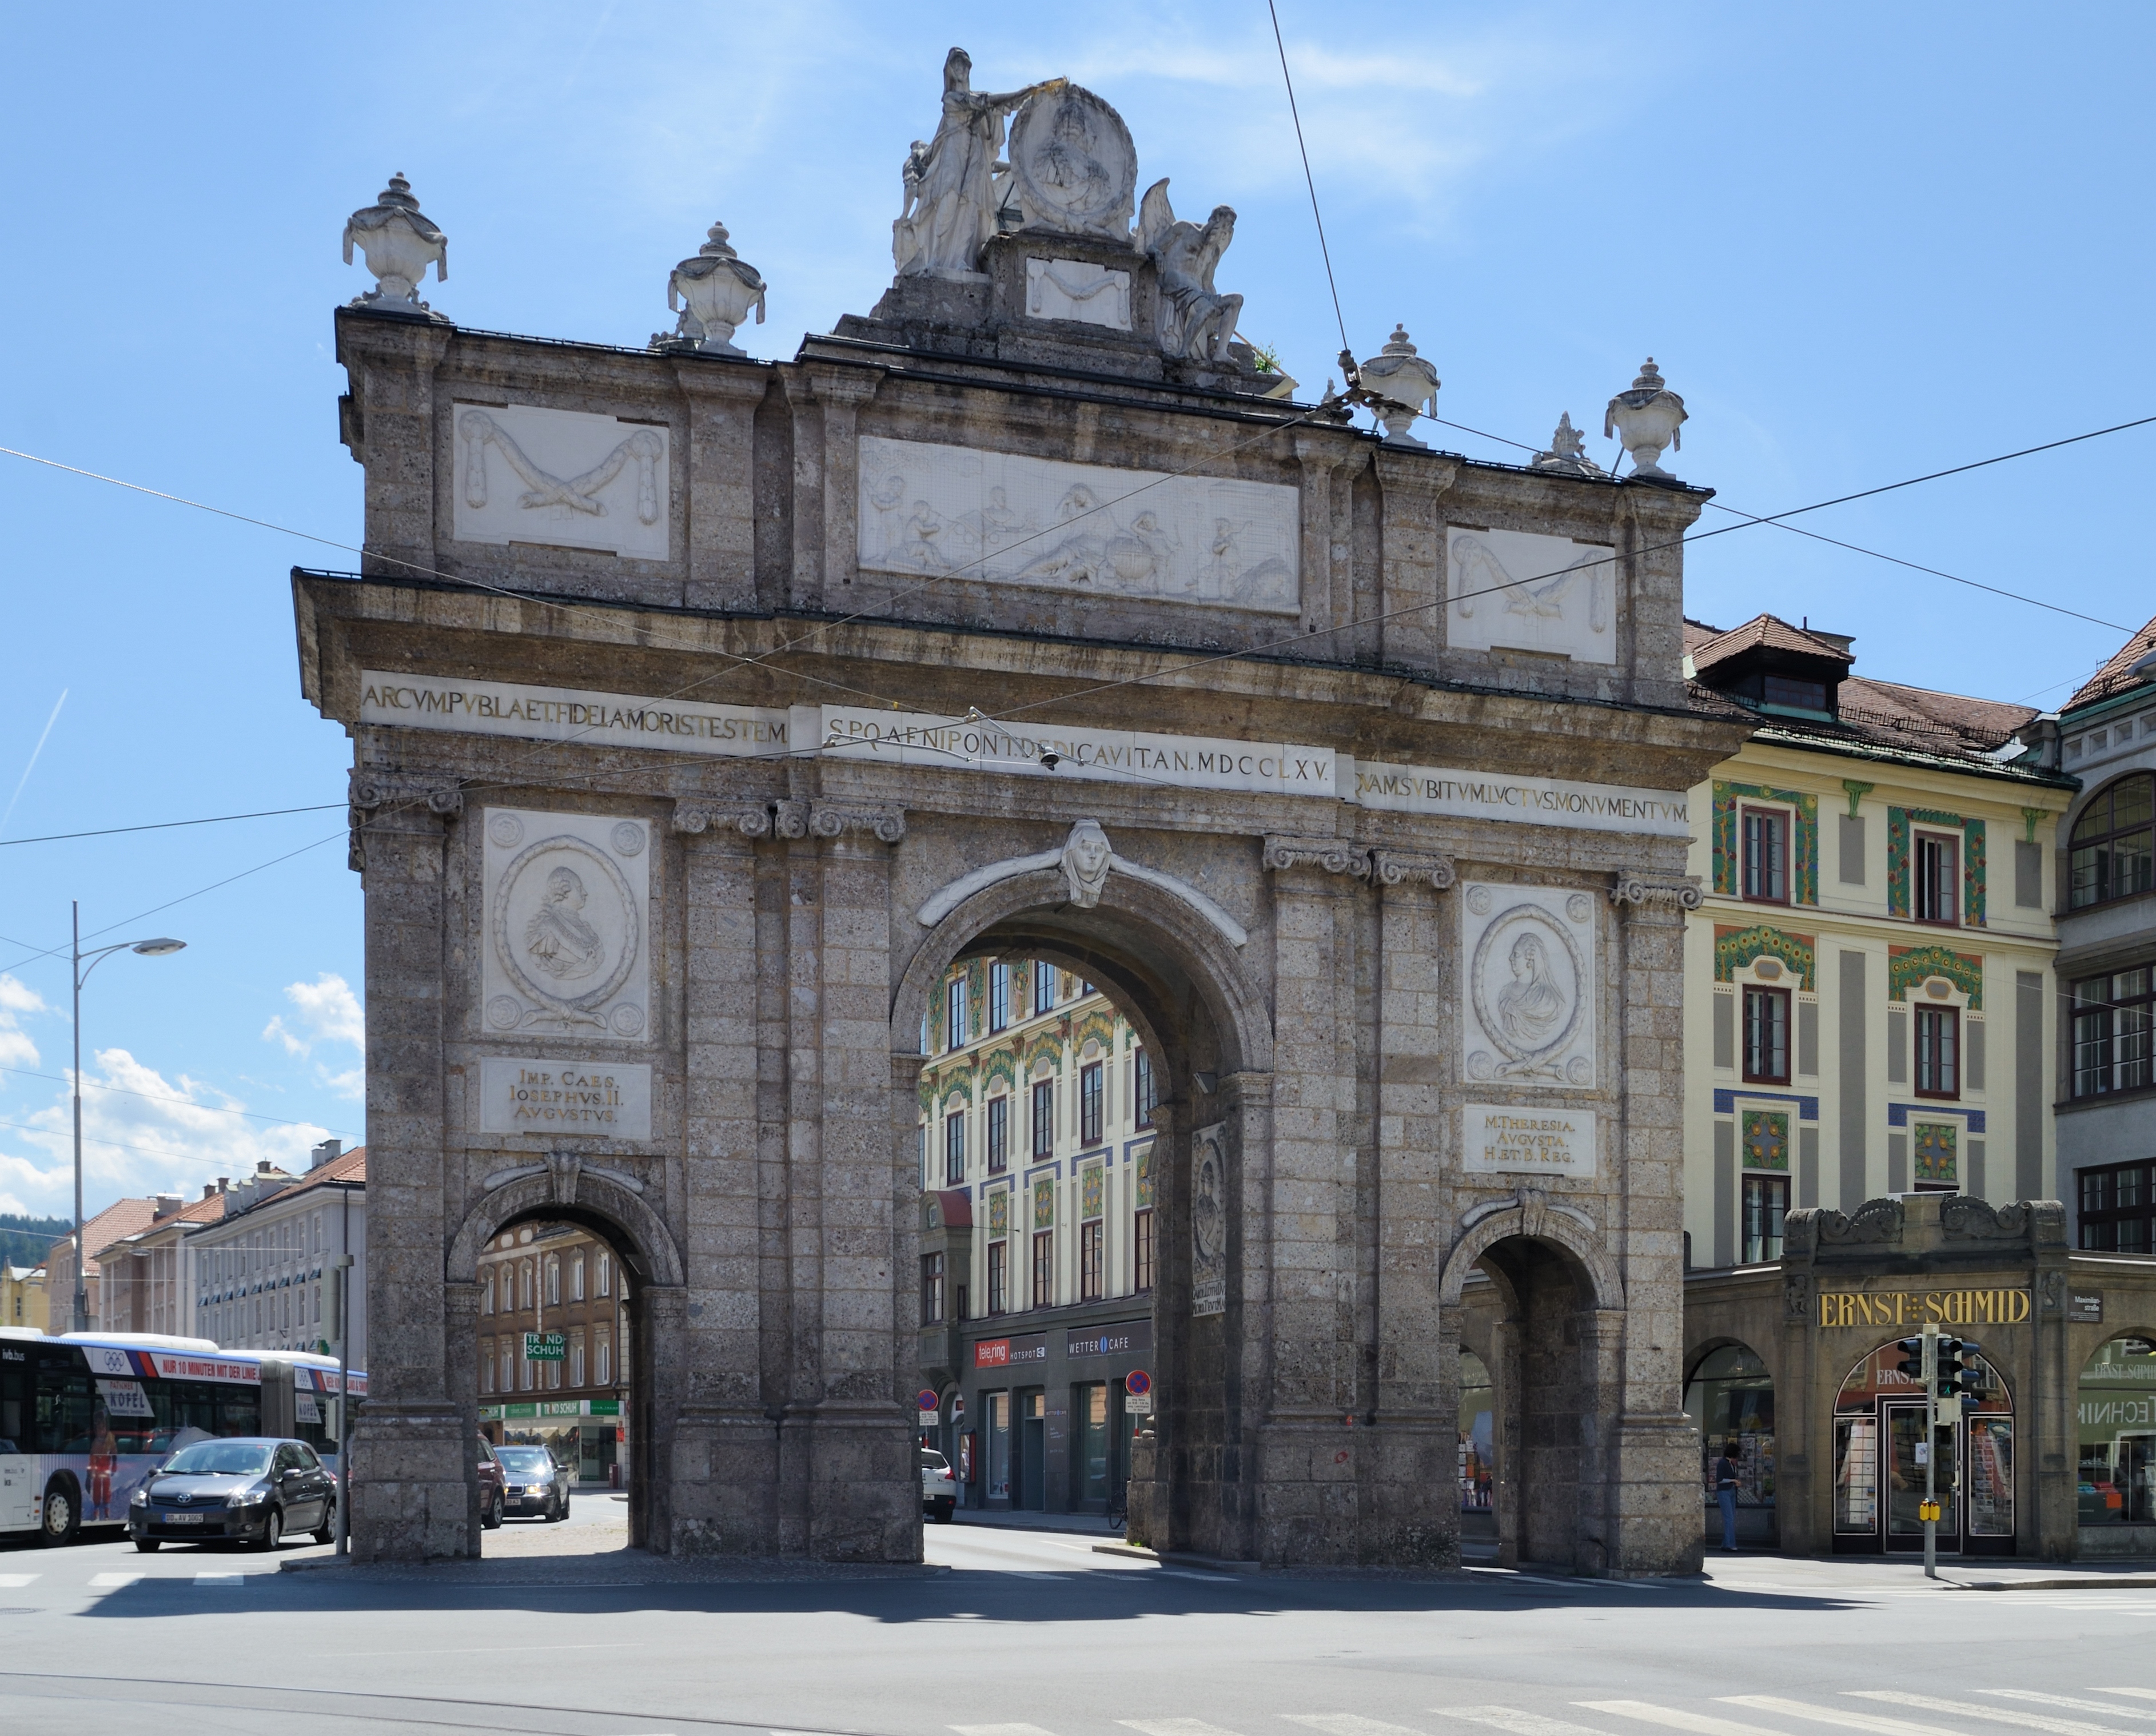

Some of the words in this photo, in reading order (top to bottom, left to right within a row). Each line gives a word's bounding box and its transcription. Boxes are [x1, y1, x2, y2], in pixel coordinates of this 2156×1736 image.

[1820, 1293, 1908, 1326] ERNST
[1925, 1291, 2030, 1324] SCHMID
[527, 1334, 563, 1344] TRND
[1069, 1340, 1099, 1353] WETTER
[1109, 1337, 1129, 1349] CAFE
[2, 1348, 25, 1361] ivb.bus
[527, 1345, 564, 1355] SCHUH
[1010, 1350, 1037, 1360] HOTSPOT
[163, 1359, 177, 1373] NUR
[178, 1361, 186, 1375] 10
[188, 1362, 215, 1377] MINUTEN
[217, 1364, 228, 1377] MIT
[229, 1365, 241, 1379] DER
[242, 1367, 256, 1380] LINIE
[110, 1392, 145, 1408] KOFEL
[560, 1402, 577, 1414] SCHUH
